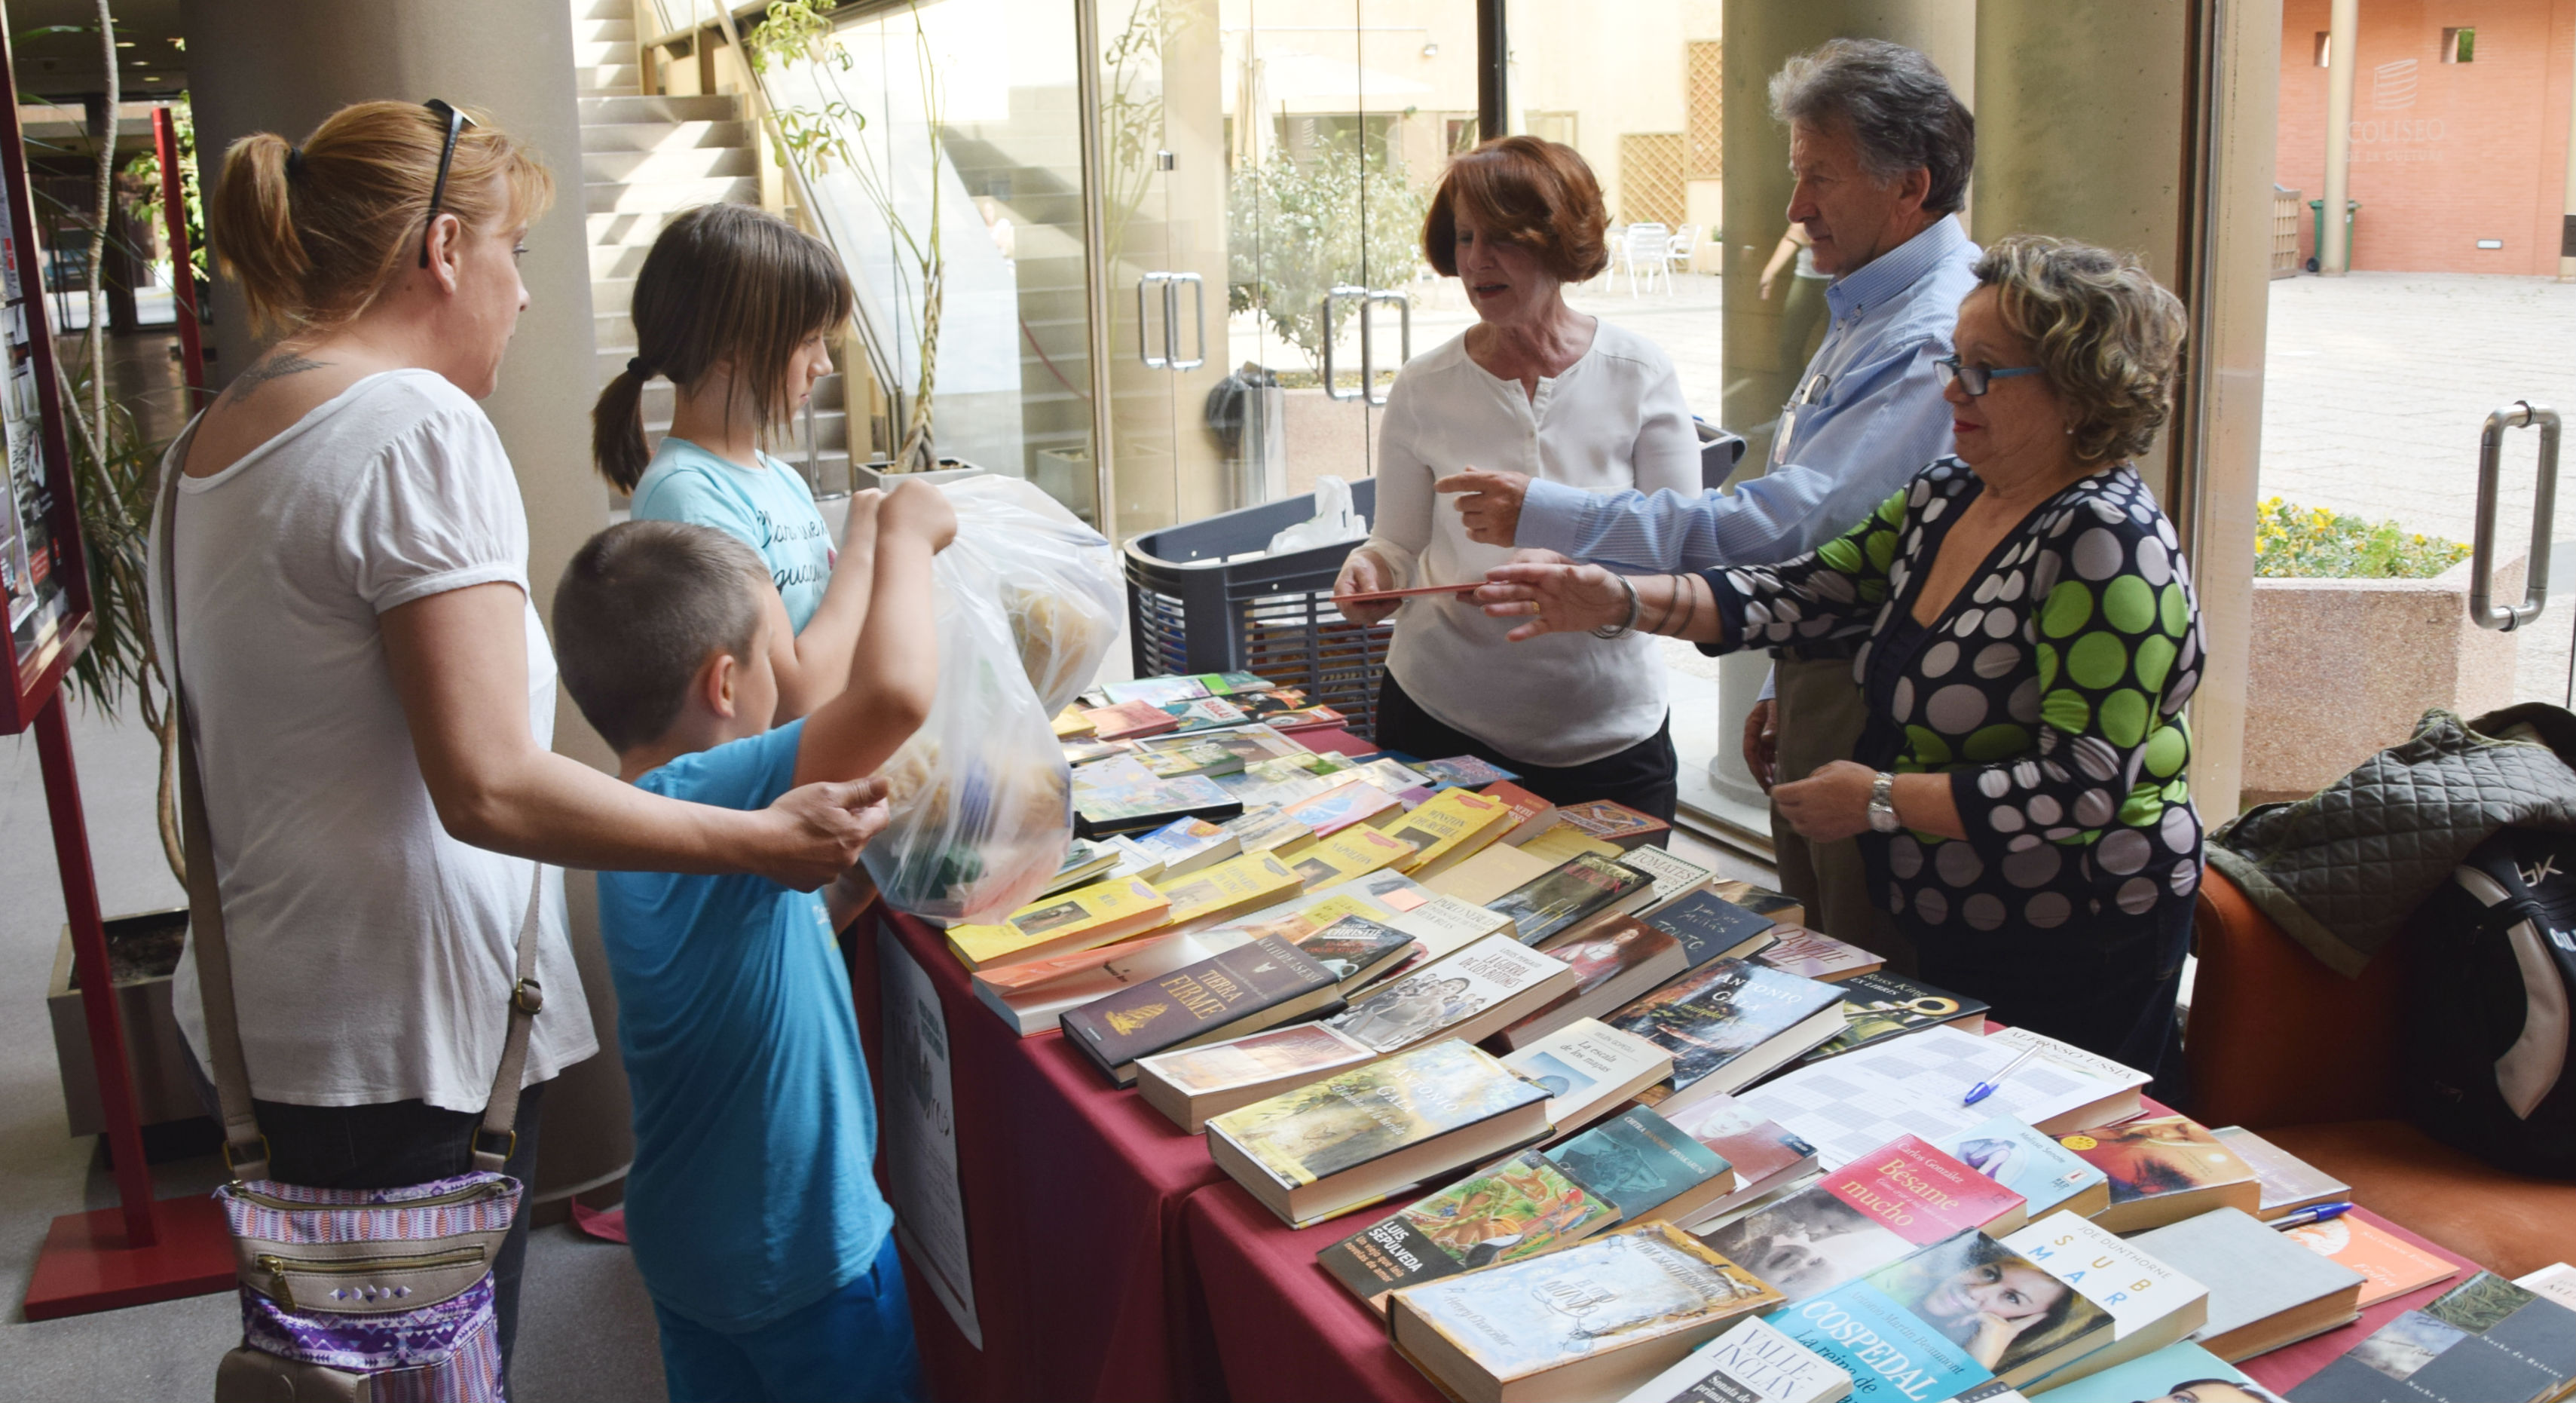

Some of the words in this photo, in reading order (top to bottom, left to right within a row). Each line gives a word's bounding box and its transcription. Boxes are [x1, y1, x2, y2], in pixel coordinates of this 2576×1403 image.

[2346, 119, 2445, 143] COLISEO
[1409, 815, 1461, 838] CHURCHILL
[1427, 809, 1468, 828] WINSTON
[1633, 852, 1695, 880] TOMATES
[1415, 908, 1454, 929] MEMORIAS
[1433, 897, 1464, 916] PABLO
[1464, 908, 1501, 928] NERUDA
[1326, 927, 1383, 937] CHRISTIE
[1773, 929, 1853, 963] DANIELLE
[1254, 938, 1296, 967] MATILDE
[1292, 958, 1324, 984] ASENSI
[1458, 957, 1479, 968] DE
[1468, 960, 1490, 975] LOS
[1482, 953, 1502, 964] LA
[1493, 958, 1531, 976] GUERRA
[1197, 969, 1244, 1003] TIERRA
[1481, 968, 1524, 988] BOTONES
[1715, 973, 1804, 1003] ANTONIO
[1849, 977, 1865, 986] EX
[1864, 982, 1901, 996] LIBRIS
[1863, 973, 1895, 985] Ross
[1895, 983, 1929, 997] King
[1159, 973, 1228, 1020] FIRME
[1712, 991, 1761, 1011] GALA
[1577, 1040, 1592, 1049] La
[1590, 1048, 1617, 1062] escala
[2012, 1031, 2083, 1058] ALFONSO
[1570, 1049, 1585, 1058] los
[1583, 1058, 1612, 1073] mapas
[1376, 1085, 1416, 1114] GALA
[1388, 1068, 1460, 1112] ANTONIO
[1331, 1085, 1347, 1093] El
[1361, 1105, 1375, 1114] de
[1370, 1110, 1382, 1120] la
[1378, 1117, 1406, 1136] herida
[1624, 1116, 1646, 1134] CHITRA
[1898, 1142, 1925, 1162] Carlos
[1925, 1158, 1964, 1184] González
[1877, 1158, 1960, 1211] Bésame
[1840, 1178, 1913, 1227] mucho
[1381, 1221, 1410, 1241] LUIS
[1344, 1242, 1369, 1262] novelas
[1365, 1260, 1378, 1270] de
[1373, 1268, 1394, 1283] amor
[1355, 1236, 1367, 1245] Un
[1364, 1242, 1381, 1257] viejo
[1377, 1255, 1394, 1267] que
[1389, 1265, 1406, 1278] leía
[1368, 1228, 1424, 1273] SEPÚLVEDA
[1632, 1240, 1662, 1257] TOM
[2077, 1226, 2101, 1239] JOE
[2100, 1237, 2173, 1279] DUNTHORNE
[2353, 1264, 2397, 1288] Fedra
[1540, 1279, 1599, 1316] MUNDO
[1445, 1295, 1471, 1318] Henry
[1469, 1313, 1516, 1346] Chancellor
[1849, 1290, 1885, 1317] Antonio
[1882, 1313, 1916, 1340] Martín
[1911, 1335, 1966, 1377] Beaumont
[1742, 1329, 1817, 1381] VALLE-
[1794, 1329, 1819, 1349] La
[1815, 1345, 1857, 1376] reina
[1852, 1377, 1878, 1394] de
[1802, 1300, 1938, 1402] COSPEDAL
[2481, 1335, 2510, 1352] Noche
[2511, 1351, 2525, 1359] de
[2526, 1357, 2564, 1378] Relatos
[1708, 1375, 1739, 1397] Sonata
[1736, 1394, 1751, 1403] de
[2406, 1380, 2435, 1398] Noche
